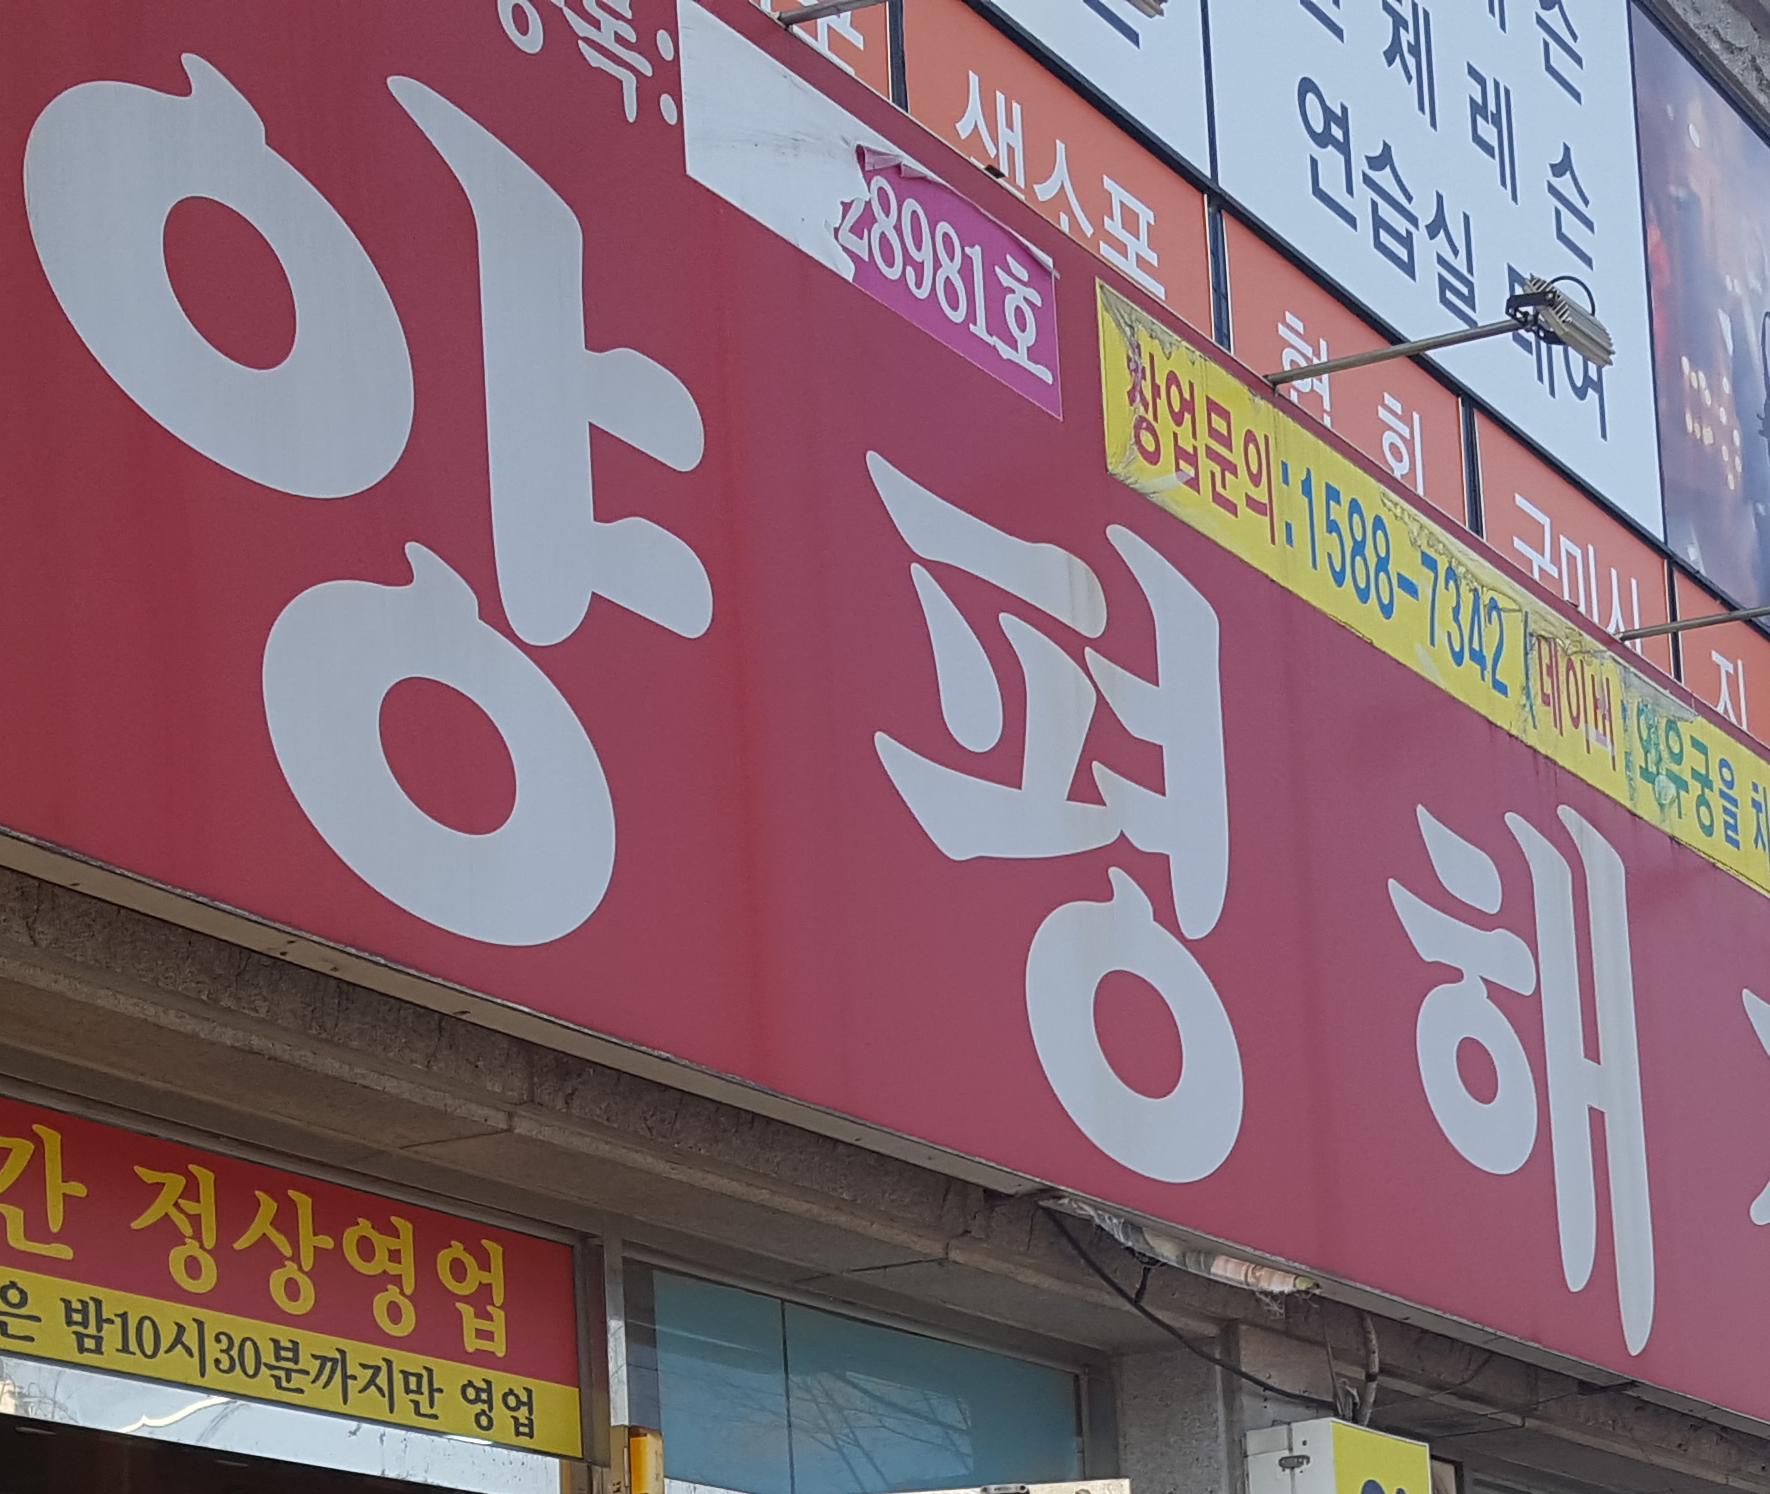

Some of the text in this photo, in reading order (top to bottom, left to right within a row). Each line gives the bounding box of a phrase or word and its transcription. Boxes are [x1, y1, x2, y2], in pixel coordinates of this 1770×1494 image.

[1296, 75, 1479, 328] 연습실
[1467, 61, 1596, 272] 레슨
[130, 1161, 508, 1360] 정상영업
[59, 1295, 444, 1422] 밤10시30분까지만
[459, 1375, 536, 1442] 영업
